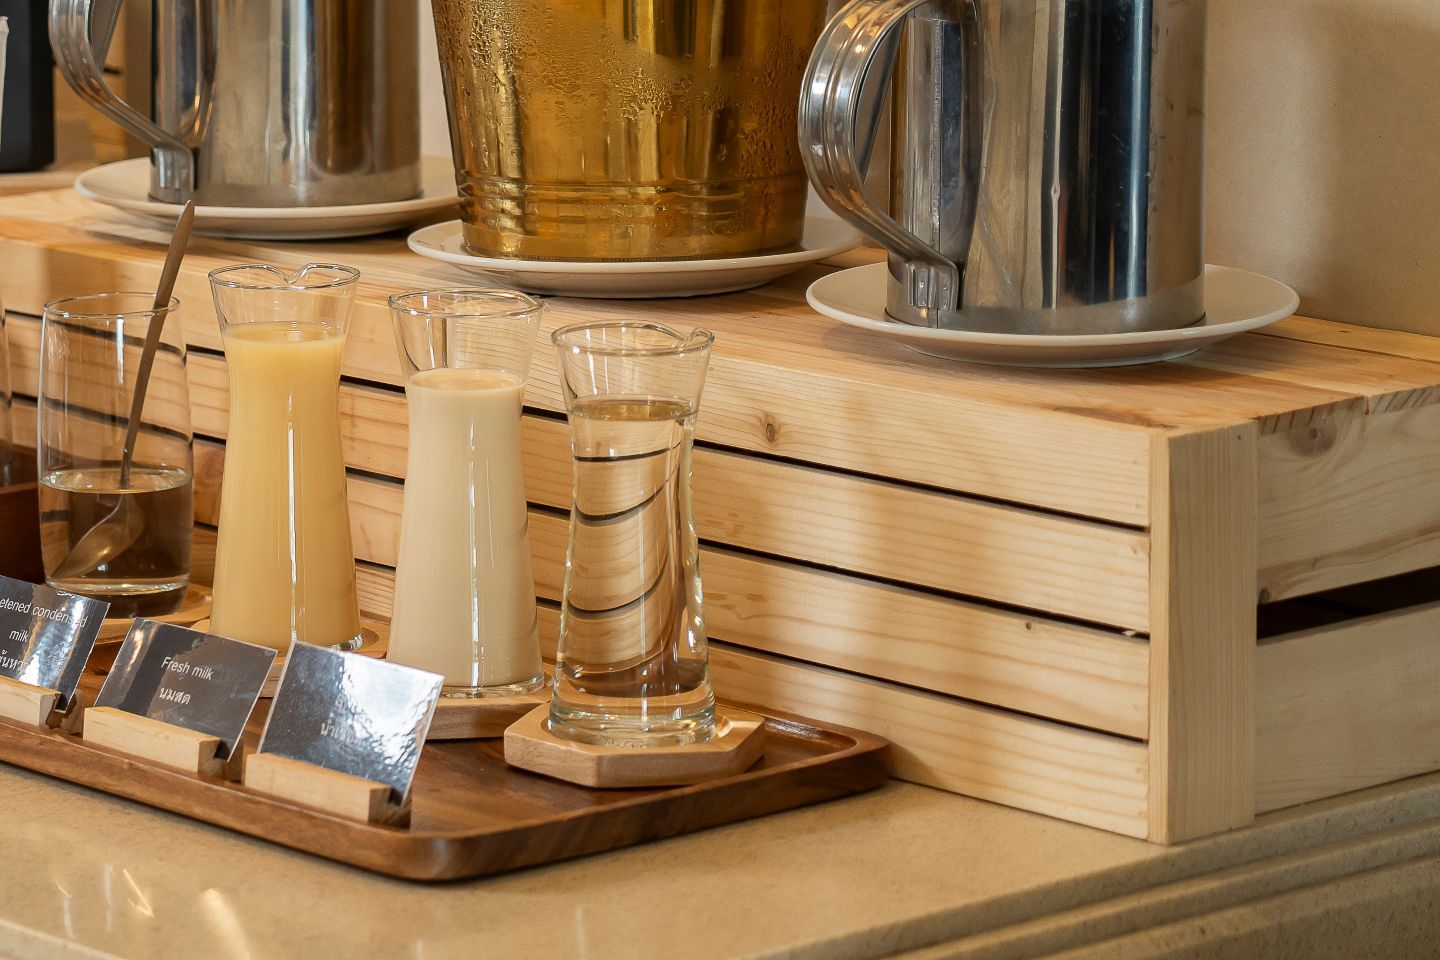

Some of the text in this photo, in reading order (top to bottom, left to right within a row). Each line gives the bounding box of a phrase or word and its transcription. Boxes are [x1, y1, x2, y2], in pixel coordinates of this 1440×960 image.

[9, 629, 30, 643] milk
[161, 656, 214, 680] Fresh milk
[159, 687, 192, 705] นมสด
